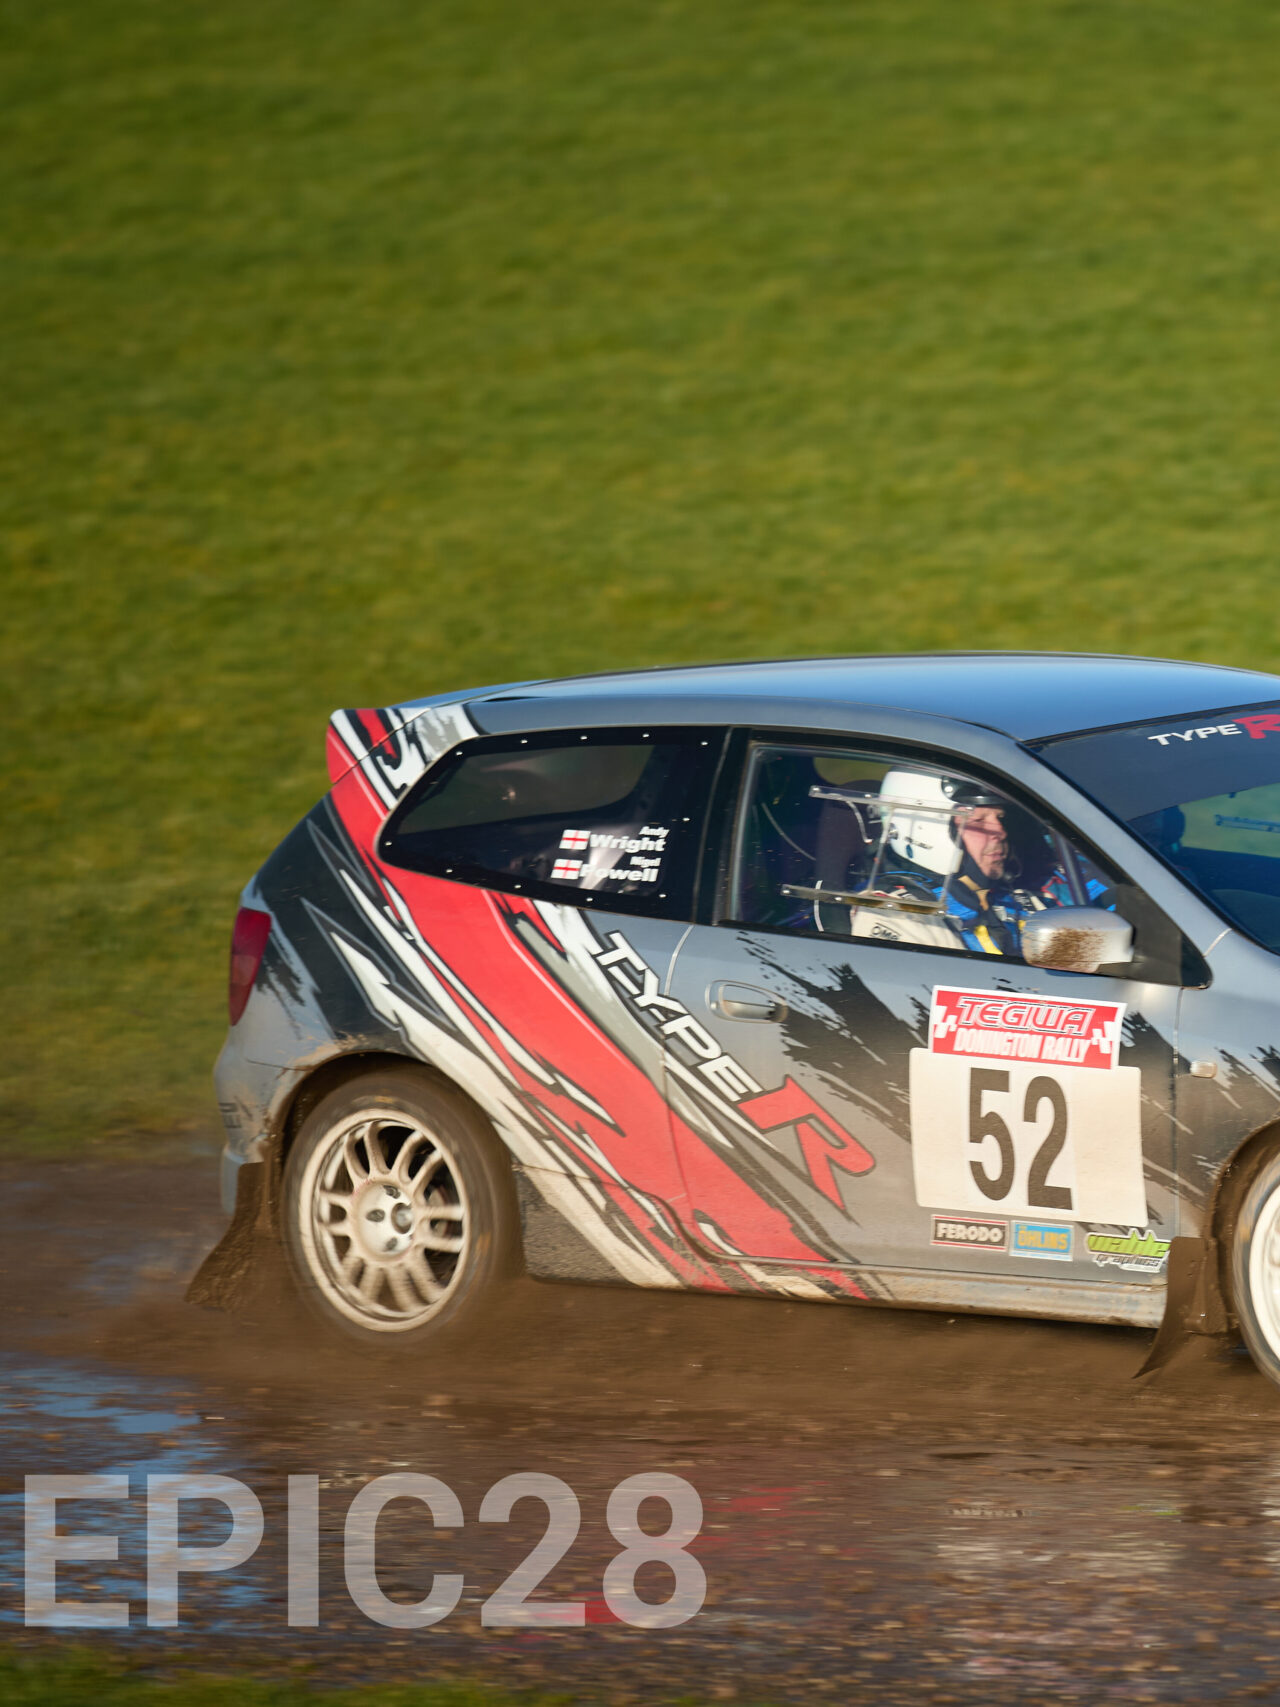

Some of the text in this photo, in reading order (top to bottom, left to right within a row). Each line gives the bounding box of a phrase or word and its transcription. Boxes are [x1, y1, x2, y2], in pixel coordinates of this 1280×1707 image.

[1148, 724, 1242, 746] TYPE
[590, 833, 666, 853] Wright
[580, 864, 658, 882] Powell
[957, 996, 1096, 1036] TEGIWA
[953, 1027, 1092, 1063] DONINGTON RALLY
[600, 931, 875, 1210] TYPE R
[969, 1067, 1073, 1210] 52
[936, 1221, 1003, 1243] FERODO
[1018, 1225, 1068, 1250] ÖHLINS
